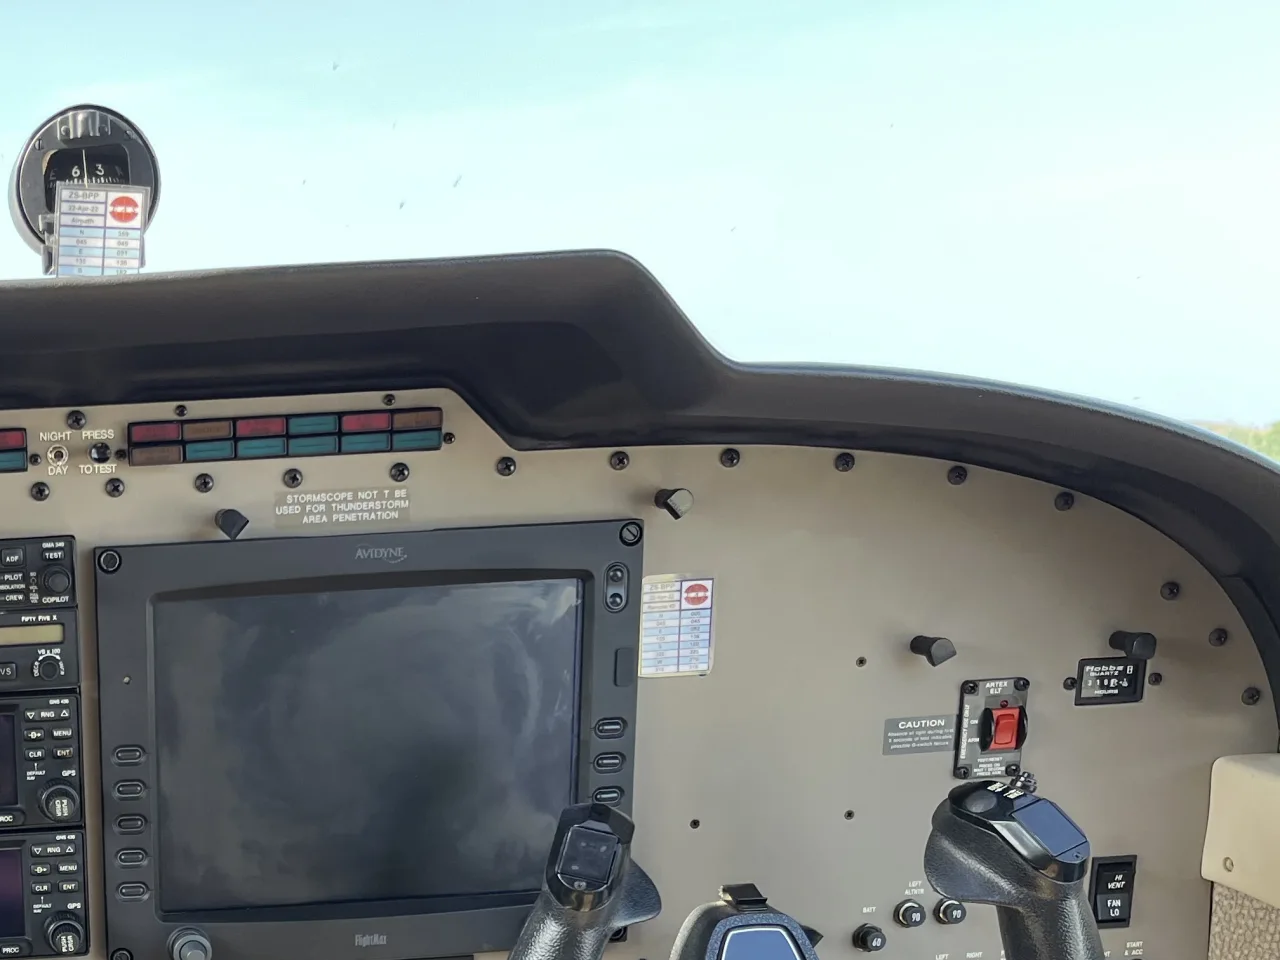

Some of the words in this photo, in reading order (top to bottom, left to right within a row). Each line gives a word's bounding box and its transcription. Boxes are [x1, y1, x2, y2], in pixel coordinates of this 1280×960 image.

[72, 166, 80, 177] 6
[96, 164, 104, 175] 3
[40, 431, 72, 441] NIGHT
[82, 429, 115, 440] PRESS
[48, 465, 68, 476] DAY
[79, 465, 93, 475] TO
[94, 464, 117, 474] TEST
[286, 492, 353, 503] STORMSCOPE
[358, 490, 378, 500] NOT
[384, 490, 389, 498] T
[394, 489, 407, 498] BE
[276, 505, 301, 515] USED
[306, 504, 326, 513] FOR
[331, 500, 409, 512] THUNDERSTORM
[302, 515, 328, 524] AREA
[333, 511, 399, 522] PENETRATION
[42, 596, 69, 604] COPILOT
[0, 668, 12, 676] VS
[985, 680, 1008, 688] ARTEX
[898, 719, 945, 729] CAUTION
[53, 728, 72, 737] MENU
[61, 769, 76, 777] GPS
[59, 864, 78, 872] MENU
[1107, 881, 1125, 889] VENT
[67, 902, 81, 910] GPS
[1107, 899, 1121, 907] FAN
[952, 909, 962, 919] 90
[1, 946, 19, 954] PROC
[935, 953, 949, 960] LEFT
